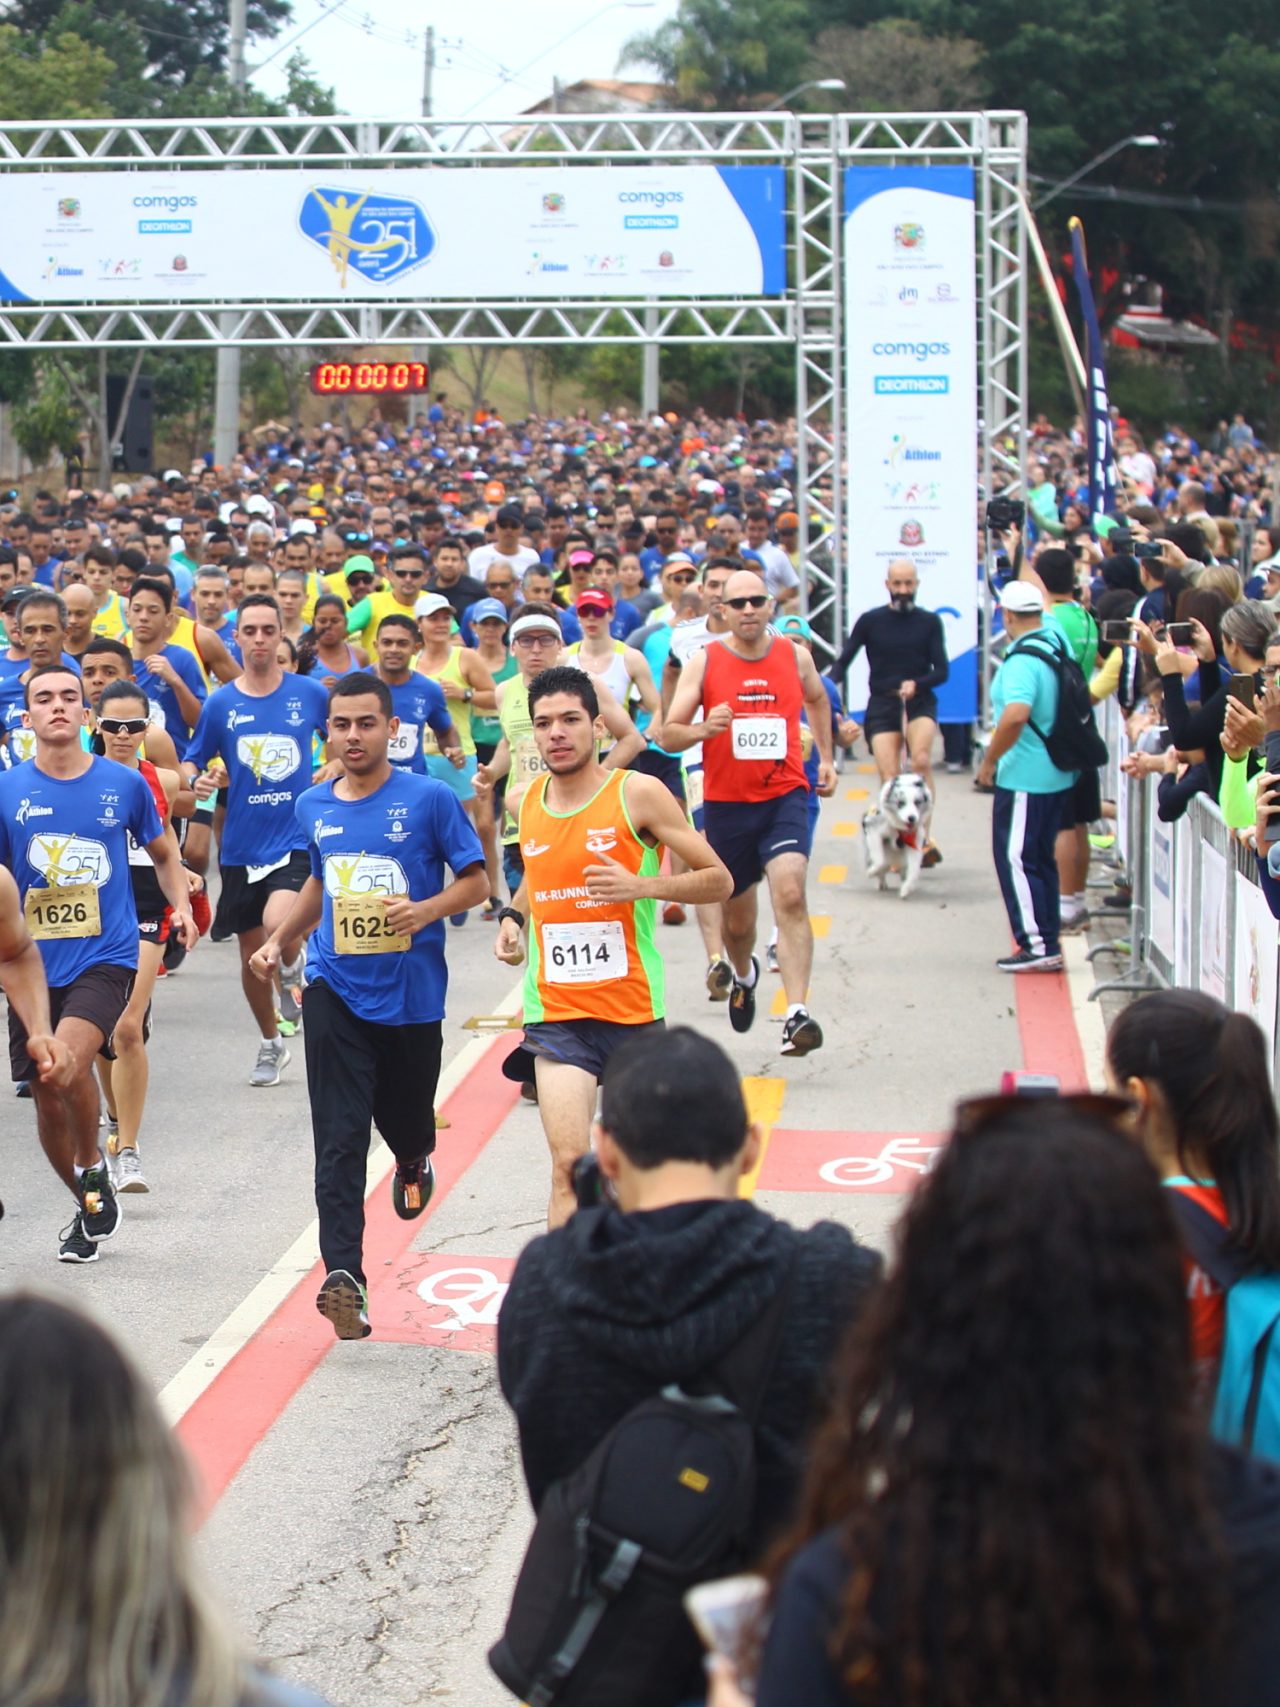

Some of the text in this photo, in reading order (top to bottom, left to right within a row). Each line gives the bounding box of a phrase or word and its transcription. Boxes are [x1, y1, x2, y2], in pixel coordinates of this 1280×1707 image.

[878, 378, 945, 391] DECATHLON
[737, 732, 779, 748] 6022
[248, 791, 293, 806] comgas
[32, 902, 88, 925] 1626
[552, 942, 611, 967] 6114
